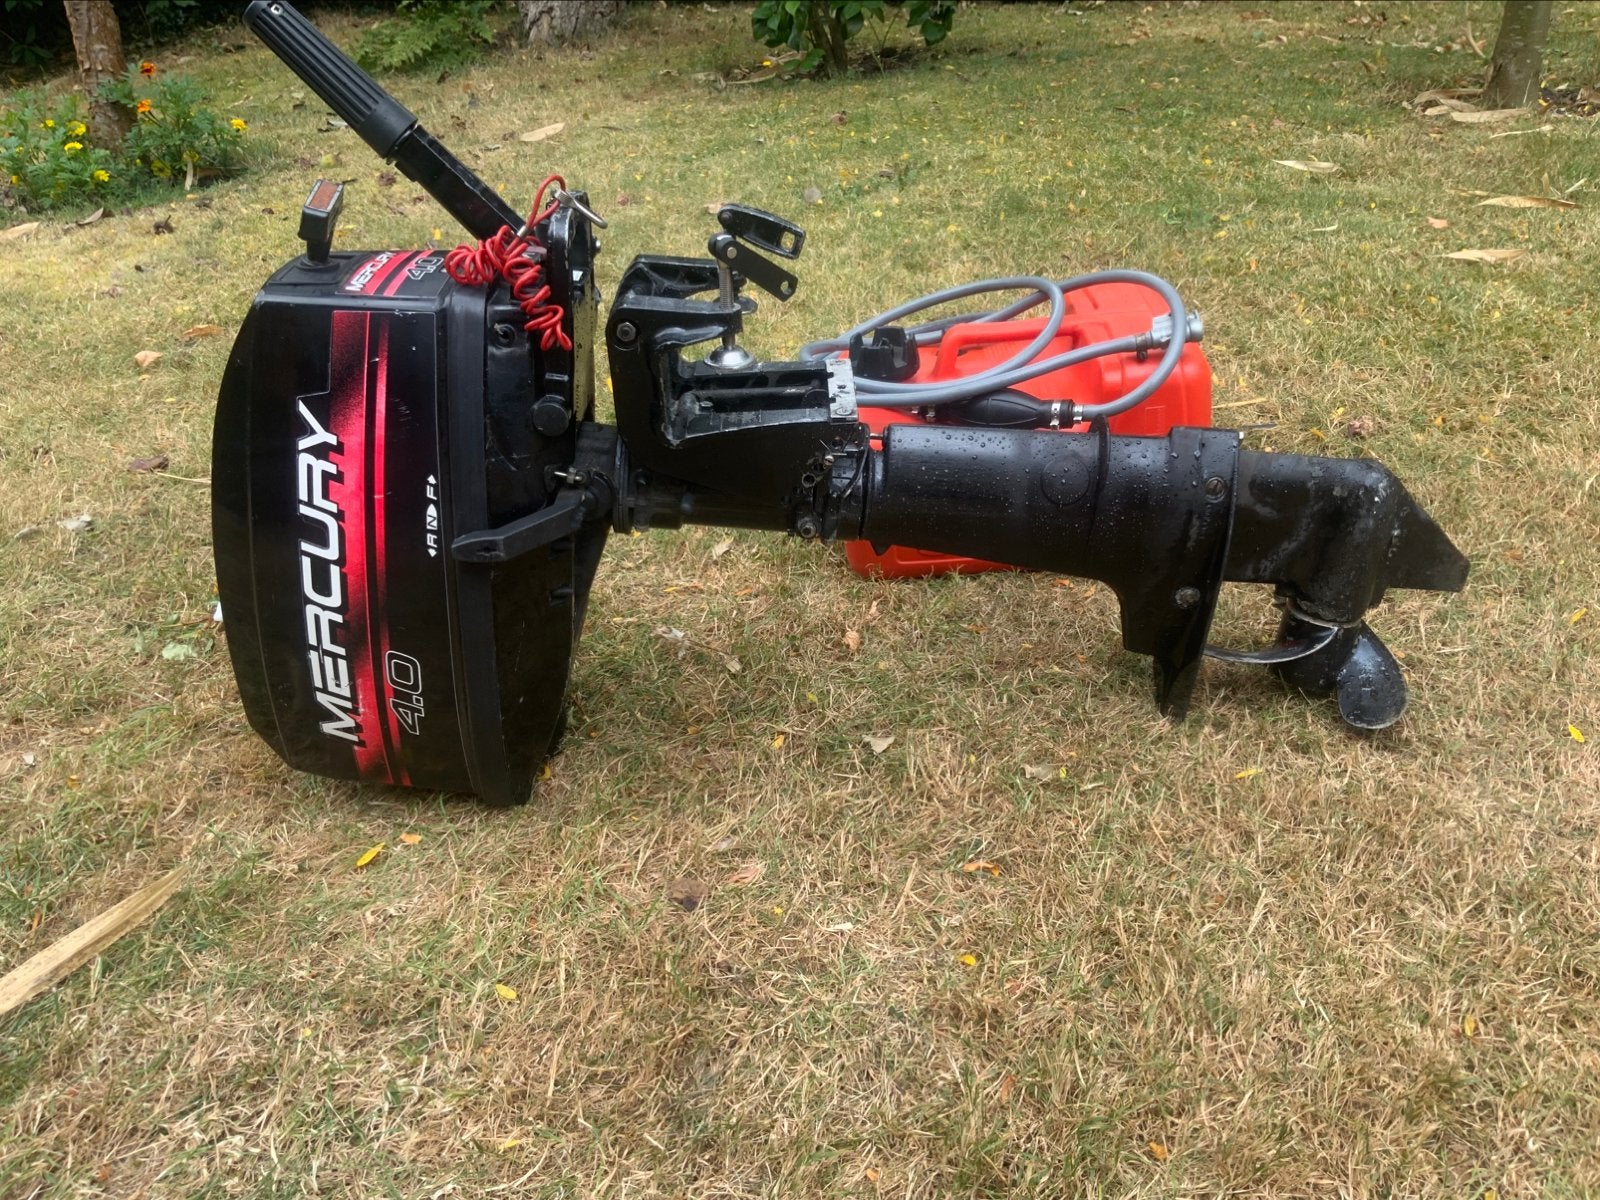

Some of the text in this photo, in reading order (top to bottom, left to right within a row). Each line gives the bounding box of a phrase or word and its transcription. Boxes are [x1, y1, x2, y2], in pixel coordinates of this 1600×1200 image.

[406, 256, 444, 280] 4.0
[298, 399, 361, 743] MERCURY
[387, 650, 425, 736] 4.0
